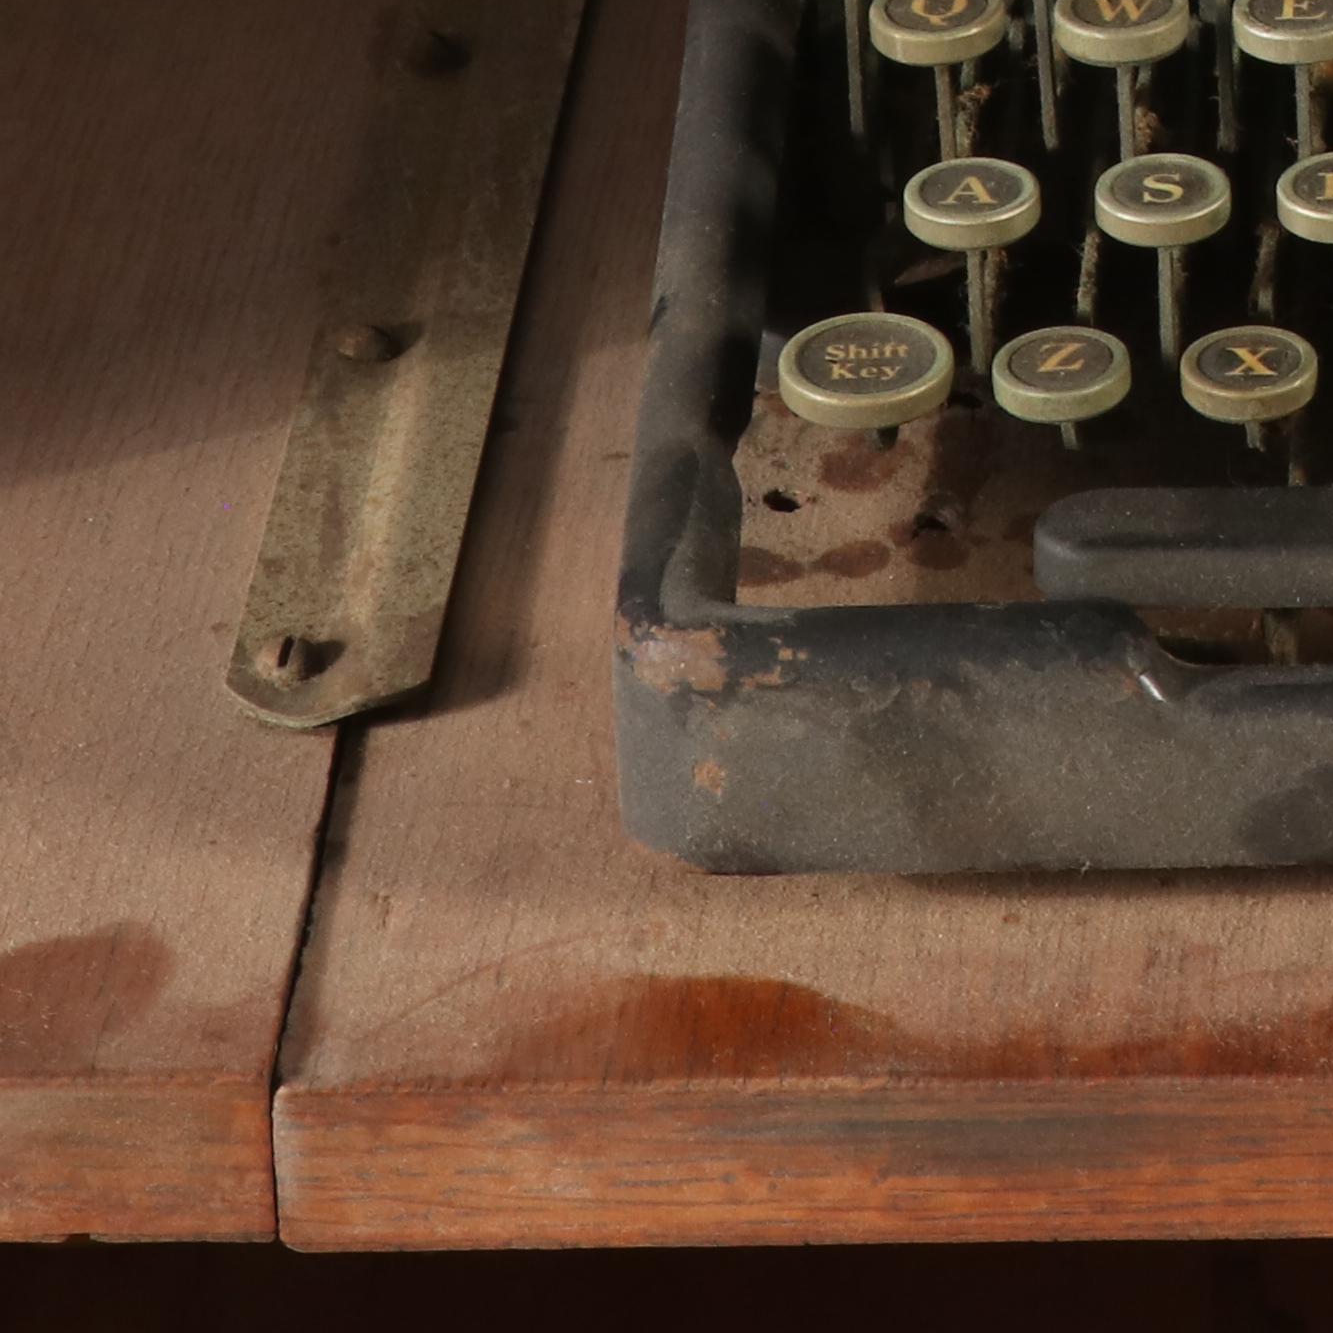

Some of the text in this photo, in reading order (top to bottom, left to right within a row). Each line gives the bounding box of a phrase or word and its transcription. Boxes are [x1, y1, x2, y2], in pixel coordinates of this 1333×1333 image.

[938, 176, 998, 205] A
[1141, 173, 1184, 203] S
[825, 342, 909, 362] Shift
[1037, 343, 1086, 373] Z
[1224, 347, 1278, 377] X
[830, 361, 901, 381] Key
